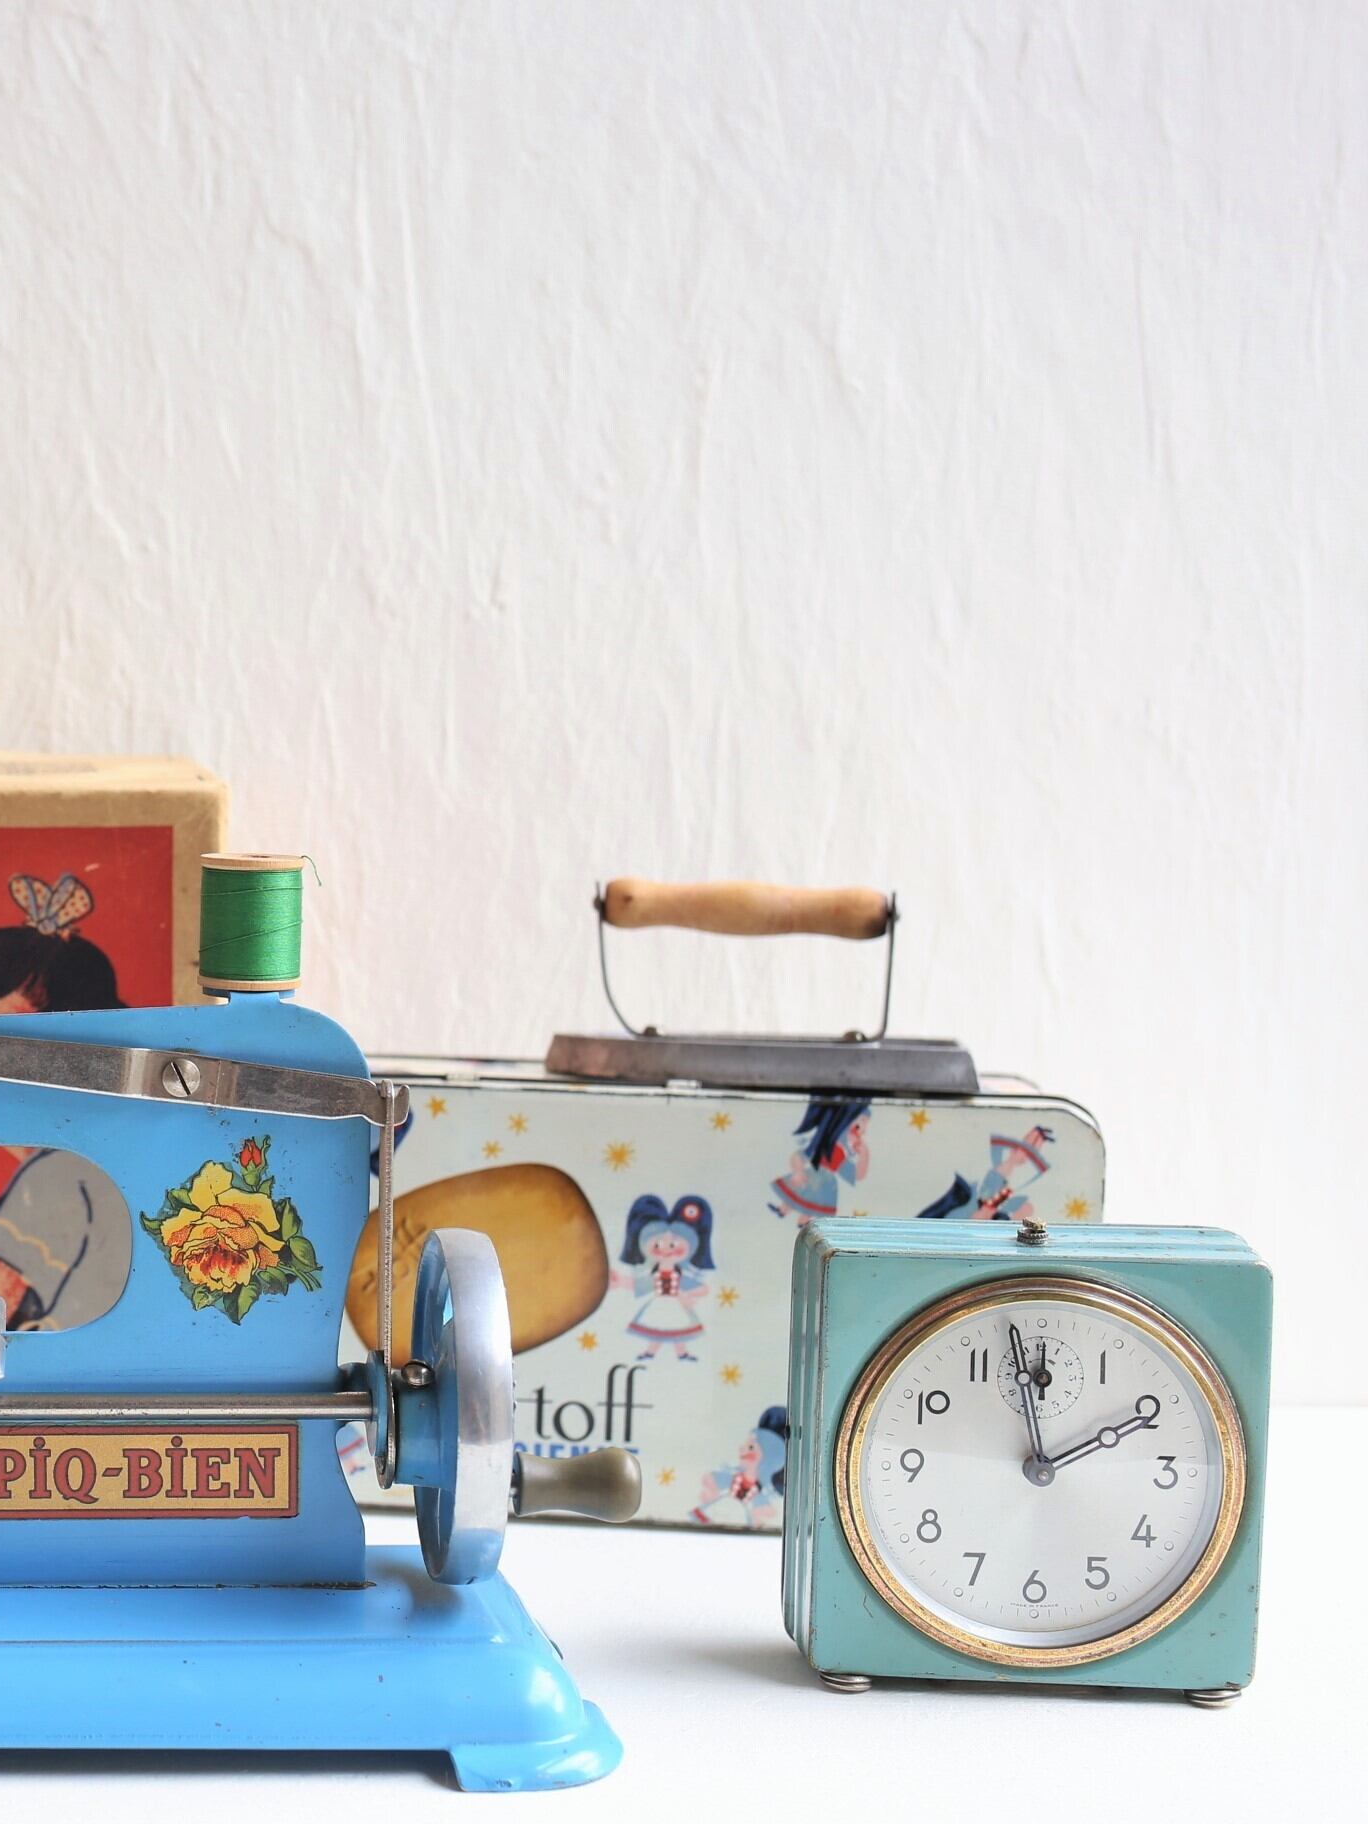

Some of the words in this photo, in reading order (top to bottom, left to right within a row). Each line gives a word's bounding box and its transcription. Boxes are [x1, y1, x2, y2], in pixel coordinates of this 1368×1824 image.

[970, 1348, 988, 1382] 11
[1100, 1350, 1106, 1385] 1
[918, 1390, 951, 1425] 10
[1135, 1394, 1160, 1430] 2
[900, 1448, 925, 1483] 9
[1153, 1455, 1179, 1490] 3
[916, 1508, 942, 1544] 8
[1131, 1514, 1158, 1548] 4
[962, 1552, 987, 1587] 7
[1022, 1569, 1047, 1604] 6
[1084, 1556, 1111, 1591] 5
